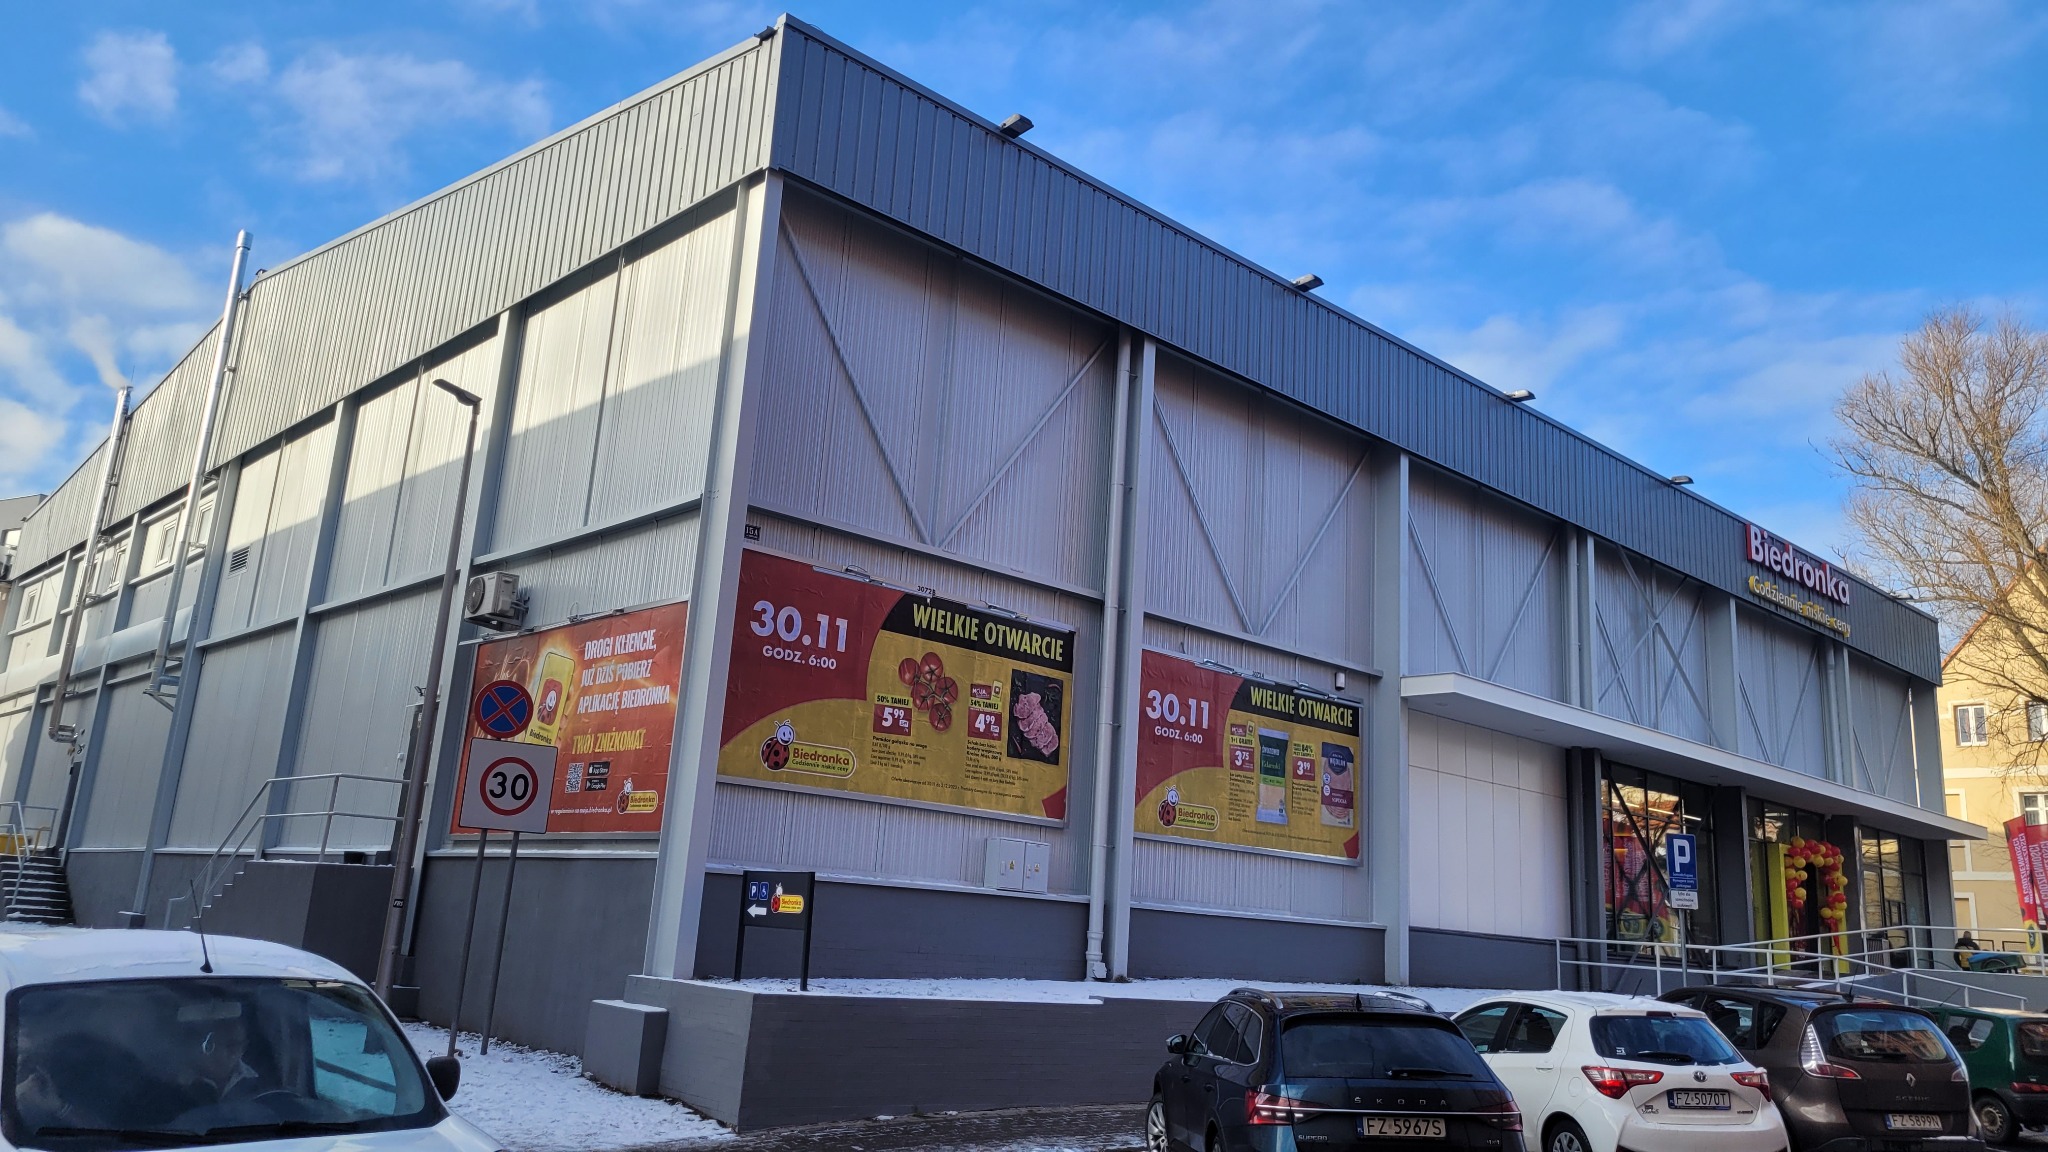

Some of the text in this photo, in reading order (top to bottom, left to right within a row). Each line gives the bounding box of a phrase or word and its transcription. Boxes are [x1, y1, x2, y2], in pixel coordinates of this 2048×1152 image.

[1746, 523, 1850, 605] Biedronka
[1748, 576, 1851, 638] Codziennie niskie ceny
[750, 600, 848, 652] 30.11
[913, 603, 1064, 662] WIELKIE OTWARCIE
[584, 629, 656, 660] DROGI KLIENCIE,
[763, 646, 836, 669] GODZ. 6:00
[581, 664, 595, 687] JUŻ
[616, 659, 653, 682] POBIERZ
[577, 685, 670, 715] APLIKACJĘ BIEDRONKA
[877, 695, 909, 706] 50% TANIEJ
[982, 701, 999, 710] TANIEJ
[1146, 690, 1209, 729] 30.11
[1250, 685, 1353, 728] WIELKIE OTWARCIE
[572, 727, 646, 754] TWÓJ ZNIŻKOMAT
[1155, 726, 1203, 744] GODZ. 6:00
[793, 748, 850, 766] Biedronka
[489, 772, 529, 800] 30
[1179, 808, 1215, 821] Biedronka
[1673, 838, 1690, 873] P
[752, 886, 757, 897] P
[1355, 1096, 1447, 1105] ŠKODA
[1676, 1093, 1726, 1105] FZ 5070T
[1366, 1118, 1442, 1135] FZ 5967S
[1892, 1115, 1940, 1127] FZ 5899N
